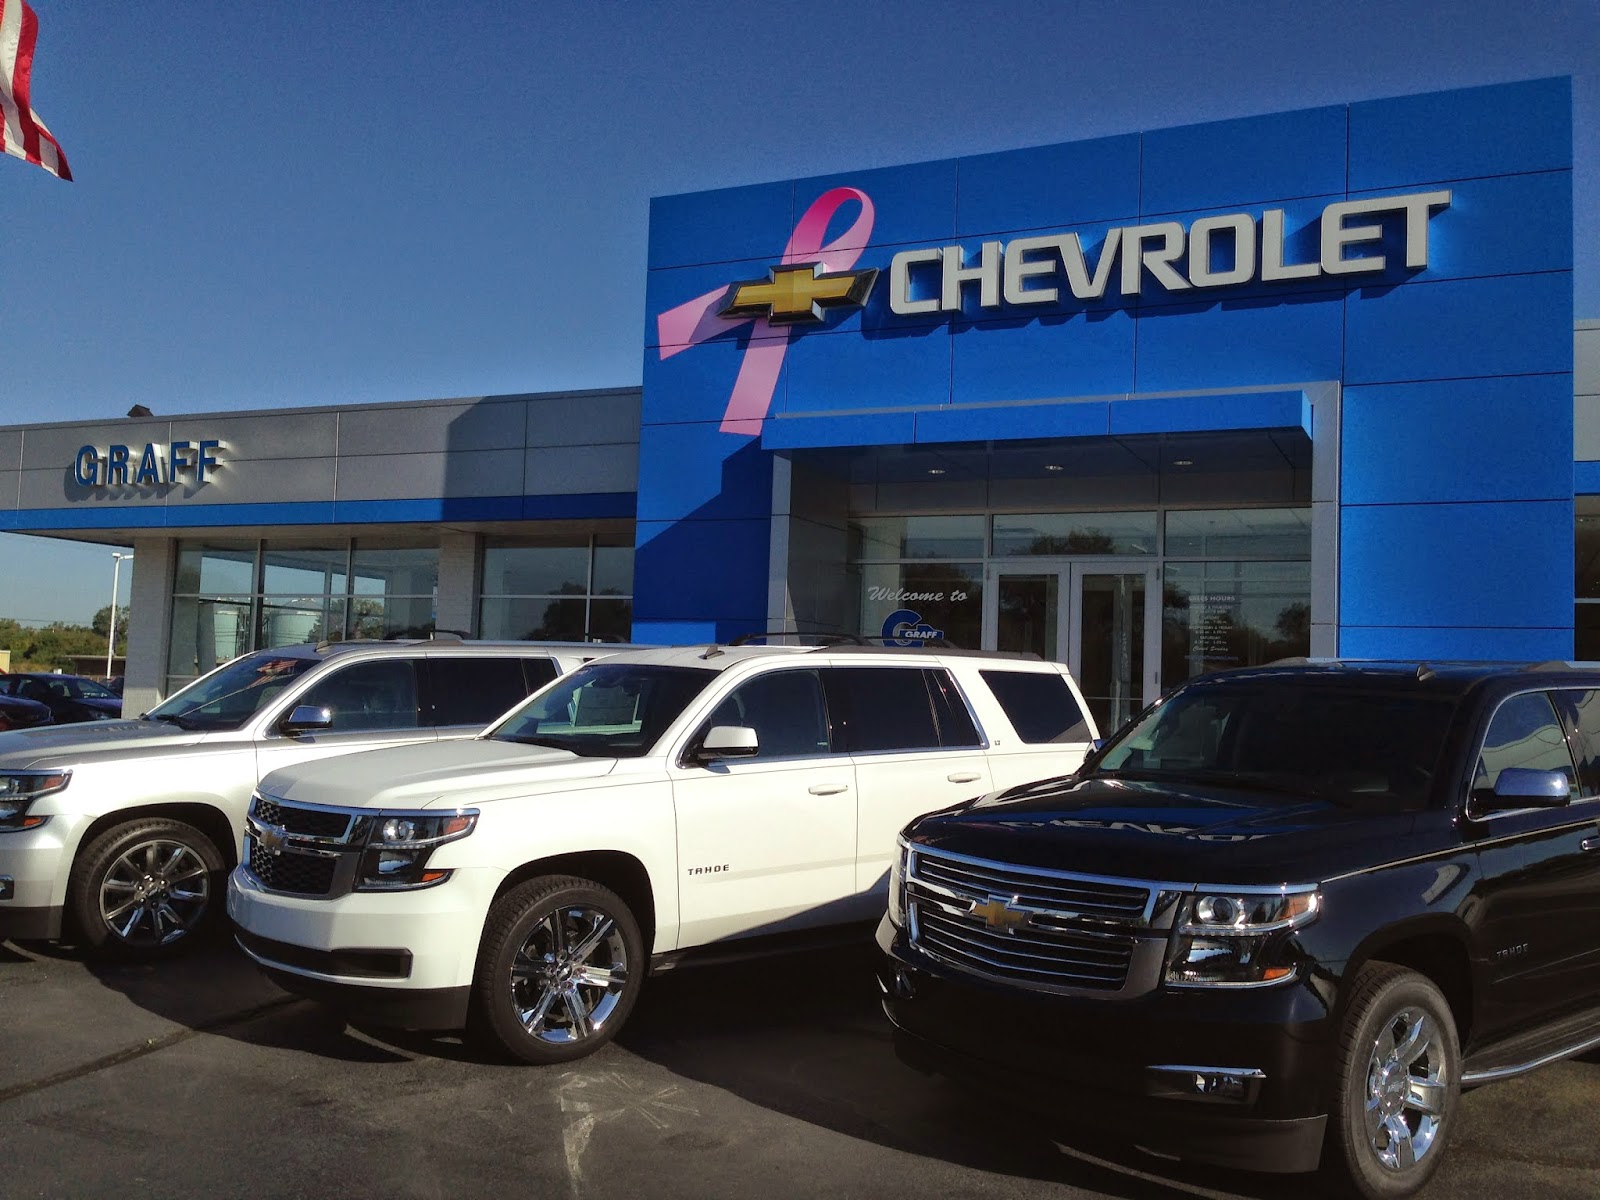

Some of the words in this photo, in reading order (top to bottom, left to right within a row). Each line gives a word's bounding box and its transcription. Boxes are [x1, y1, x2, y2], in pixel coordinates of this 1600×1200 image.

[890, 189, 1453, 315] CHEVROLET
[75, 440, 228, 487] GRAFF
[867, 586, 944, 601] Welcome
[949, 590, 968, 602] to
[905, 631, 938, 639] GRAFF
[687, 864, 730, 876] TAHOE
